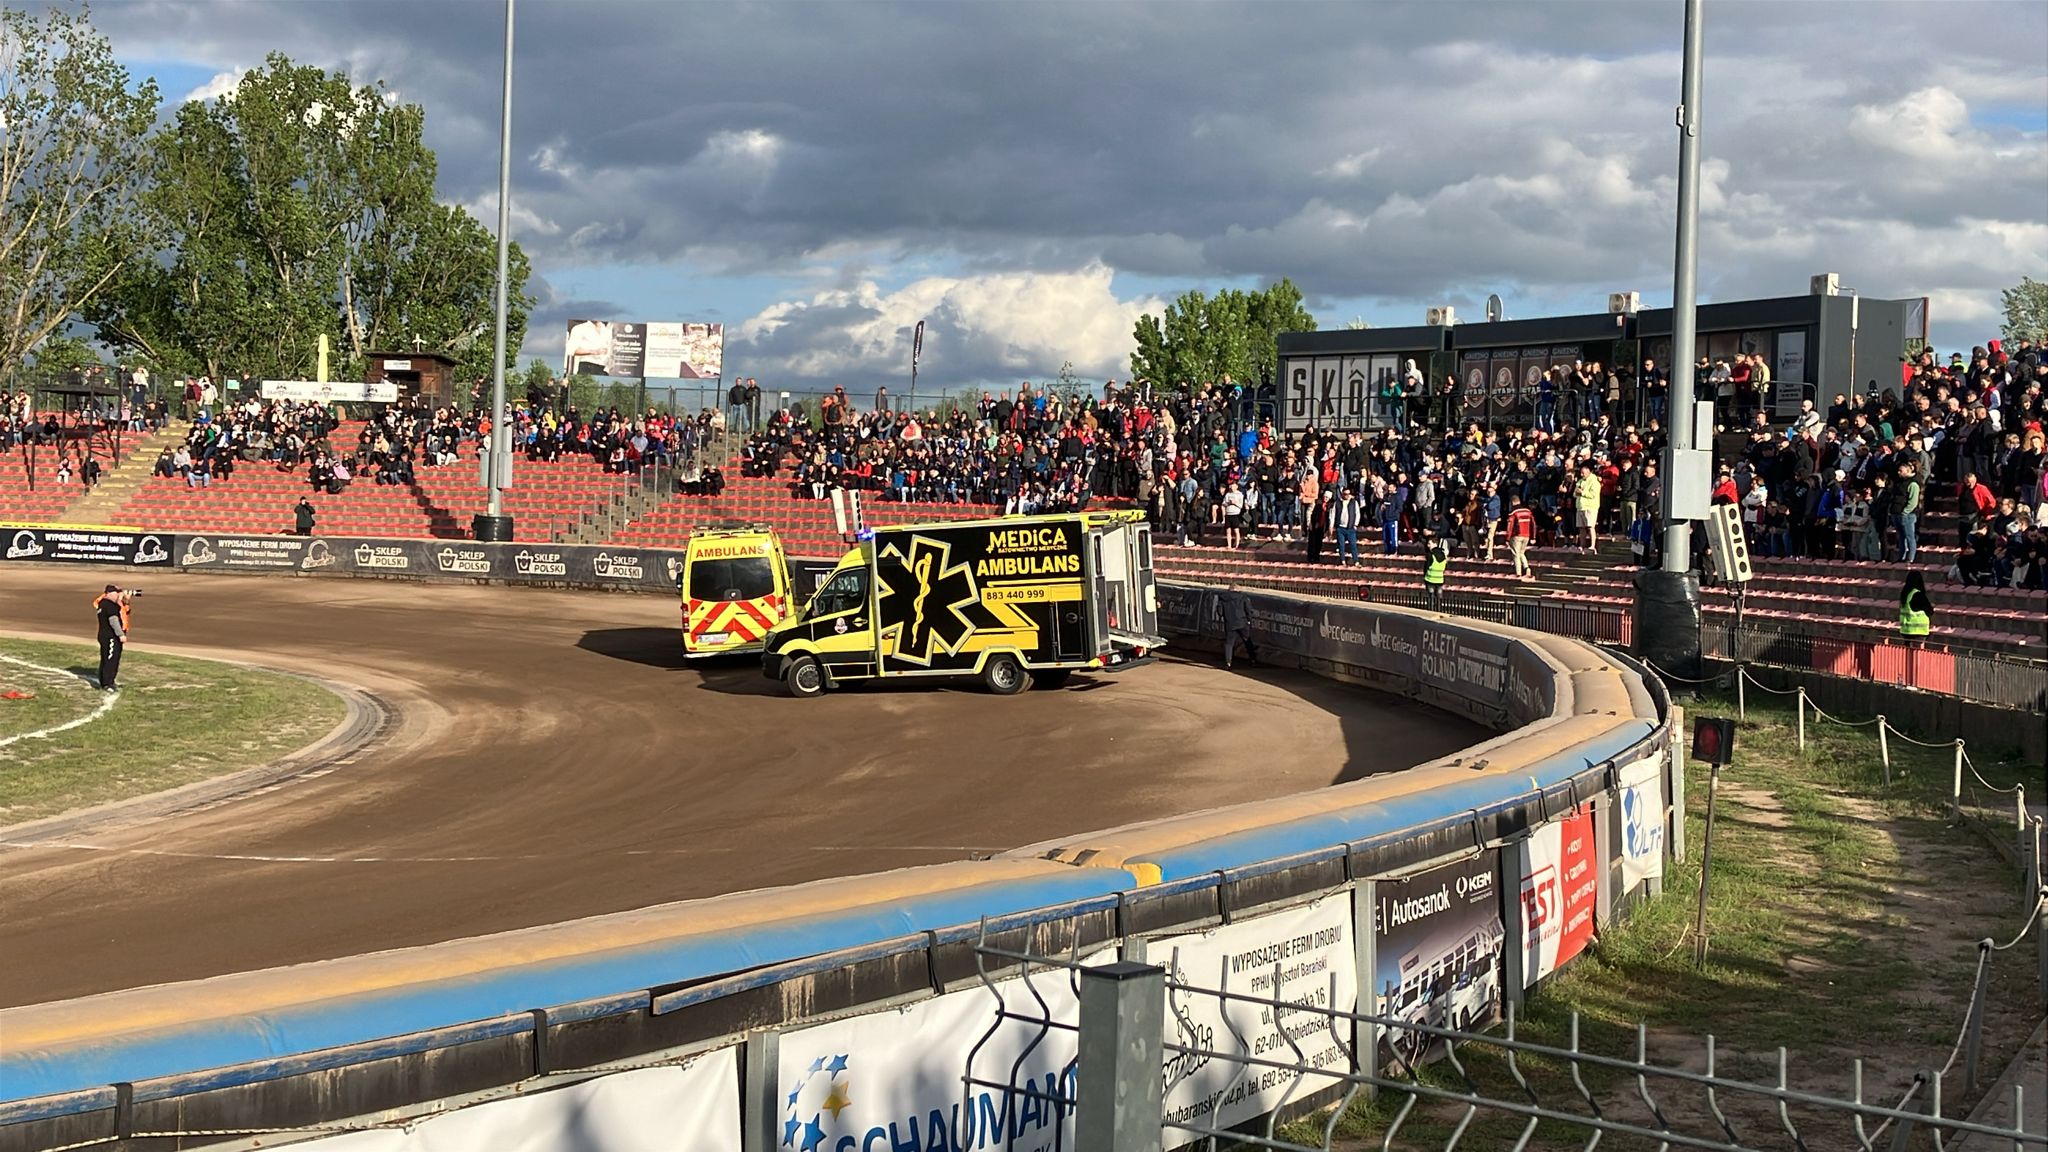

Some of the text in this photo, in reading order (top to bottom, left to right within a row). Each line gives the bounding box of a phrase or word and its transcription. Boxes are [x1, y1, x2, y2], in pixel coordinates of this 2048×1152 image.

[376, 547, 402, 556] SKLEP
[459, 551, 485, 560] SKLEP
[534, 554, 560, 562] SKLEP
[613, 556, 638, 566] SKLEP
[696, 546, 764, 558] AMBULANS
[375, 558, 406, 566] POLSKI
[459, 562, 488, 570] POLSKI
[534, 564, 564, 573] POLSKI
[612, 567, 640, 577] POLSKI
[976, 555, 1080, 576] AMBULANS
[986, 592, 1004, 600] 883
[1027, 590, 1044, 598] 999
[1340, 626, 1366, 646] Gniezno
[1422, 630, 1458, 656] PALETY
[1392, 636, 1417, 657] Gniezno
[1468, 870, 1492, 892] KGM
[1392, 883, 1450, 927] Autosanok
[1232, 925, 1342, 974] WYPOSAŻENIE FERM DROBIU
[1252, 972, 1270, 993] PPHU
[1271, 964, 1300, 987] Kysztof
[1262, 1006, 1273, 1025] ul.
[1316, 987, 1326, 1005] 16
[1254, 1032, 1285, 1056] 62-010
[1248, 1076, 1260, 1096] tel.
[1262, 1070, 1276, 1090] 692
